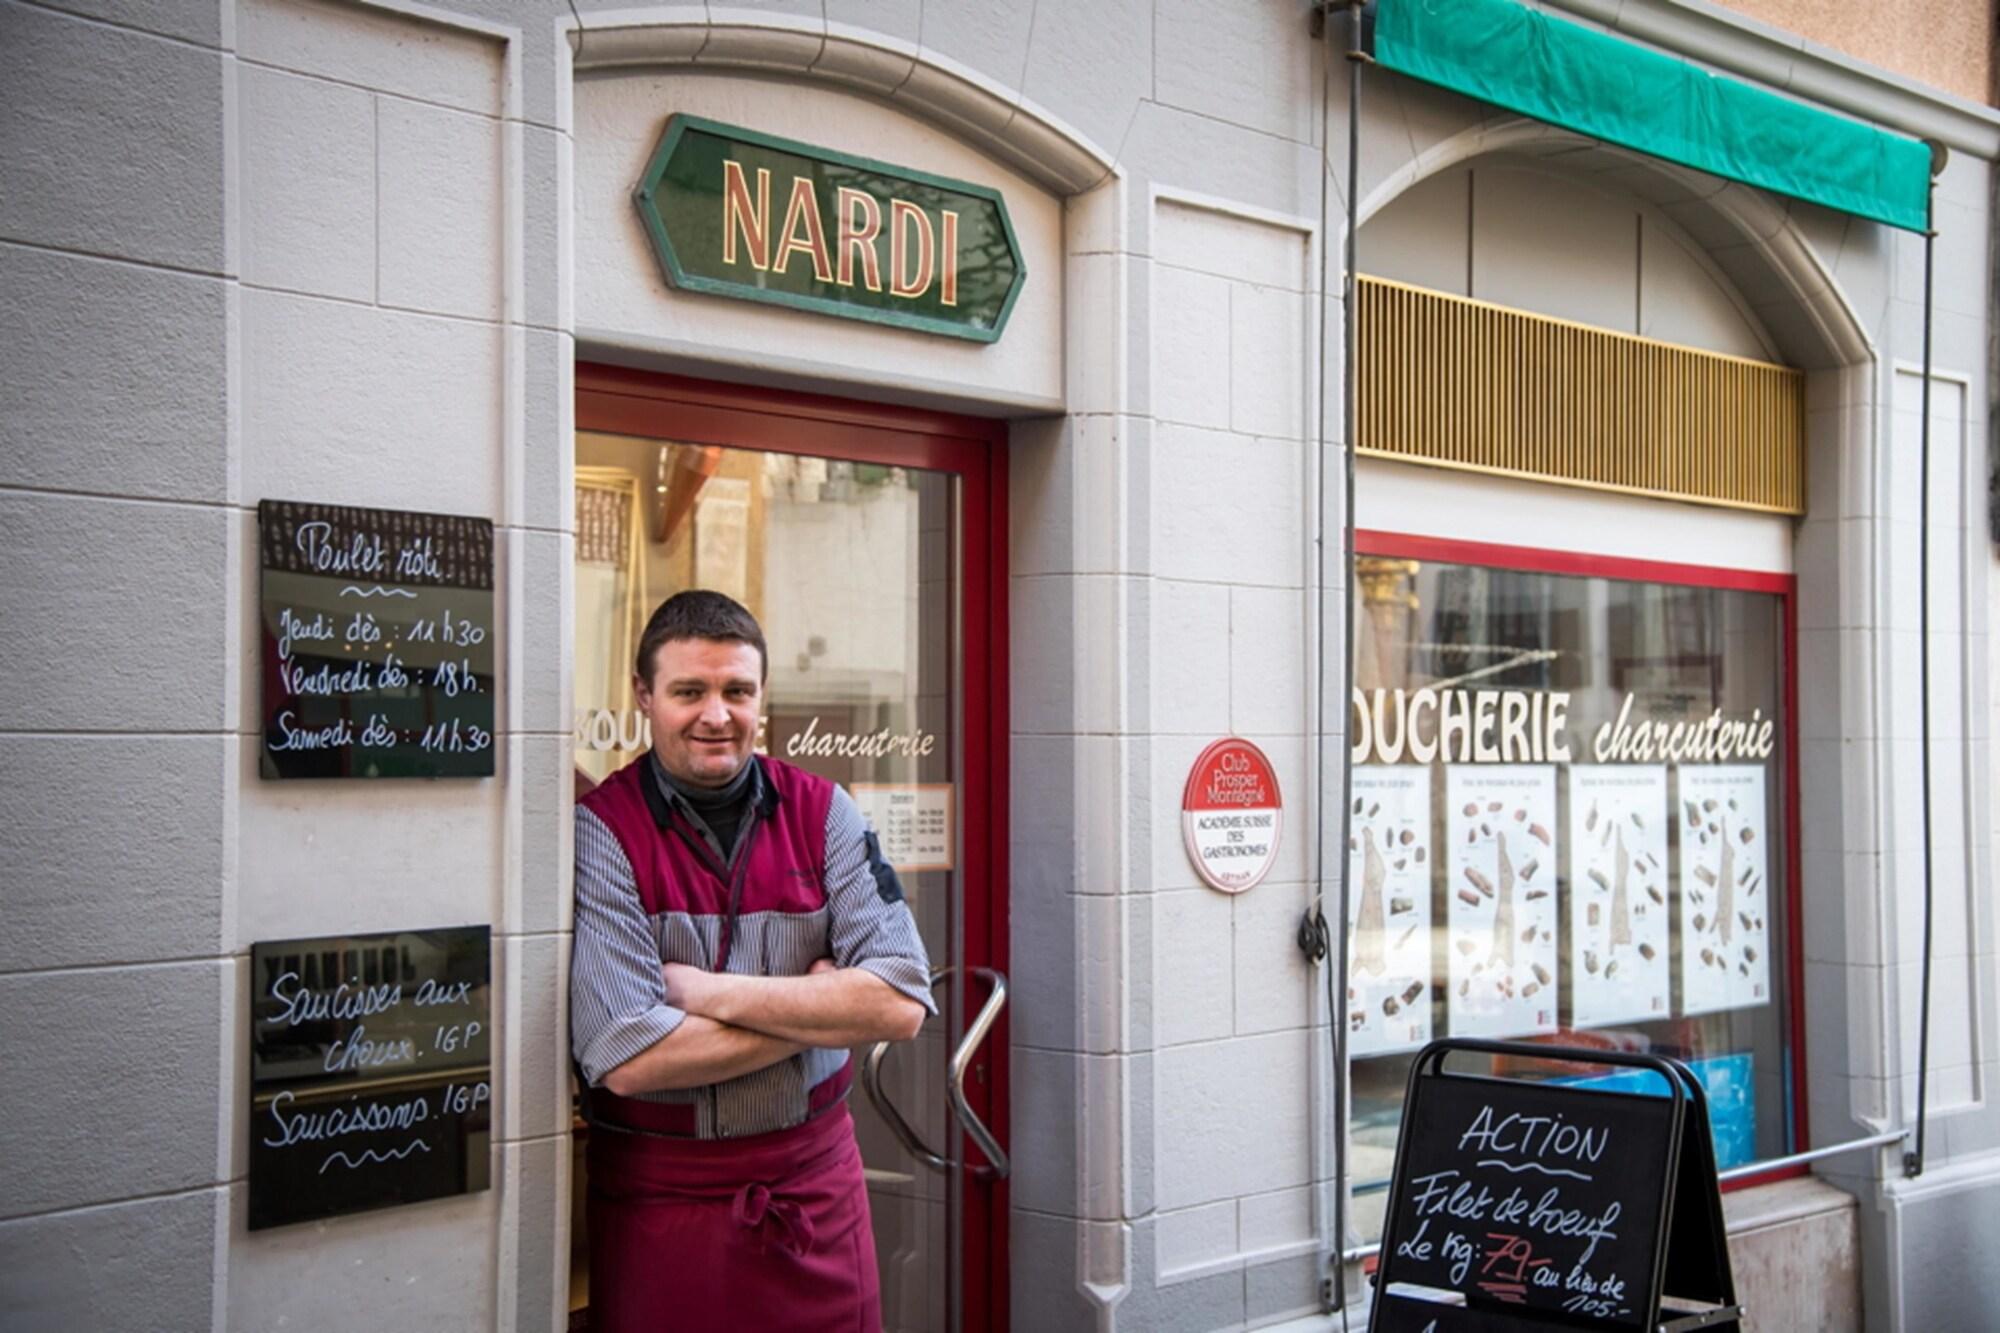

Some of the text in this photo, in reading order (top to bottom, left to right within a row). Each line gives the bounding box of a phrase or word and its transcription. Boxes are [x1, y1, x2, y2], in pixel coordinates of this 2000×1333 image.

[723, 160, 959, 306] NARDI
[297, 521, 386, 573] Poulet
[279, 608, 335, 660] Jeudi
[280, 655, 372, 695] Vendredi
[268, 711, 353, 751] Samedi
[420, 718, 490, 752] 11h30
[786, 716, 935, 757] charcuterie
[1594, 692, 1775, 763] charcuterie
[1214, 769, 1259, 790] Prosper
[1221, 753, 1250, 772] Club
[1203, 844, 1268, 859] GASTRONOMES
[1227, 830, 1244, 842] DES
[267, 972, 471, 1026] Saucisses aux
[1411, 1170, 1494, 1221] Filet
[1493, 1186, 1529, 1224] de
[1397, 1219, 1433, 1261] Le
[1533, 1265, 1561, 1287] au
[1600, 1273, 1625, 1301] de
